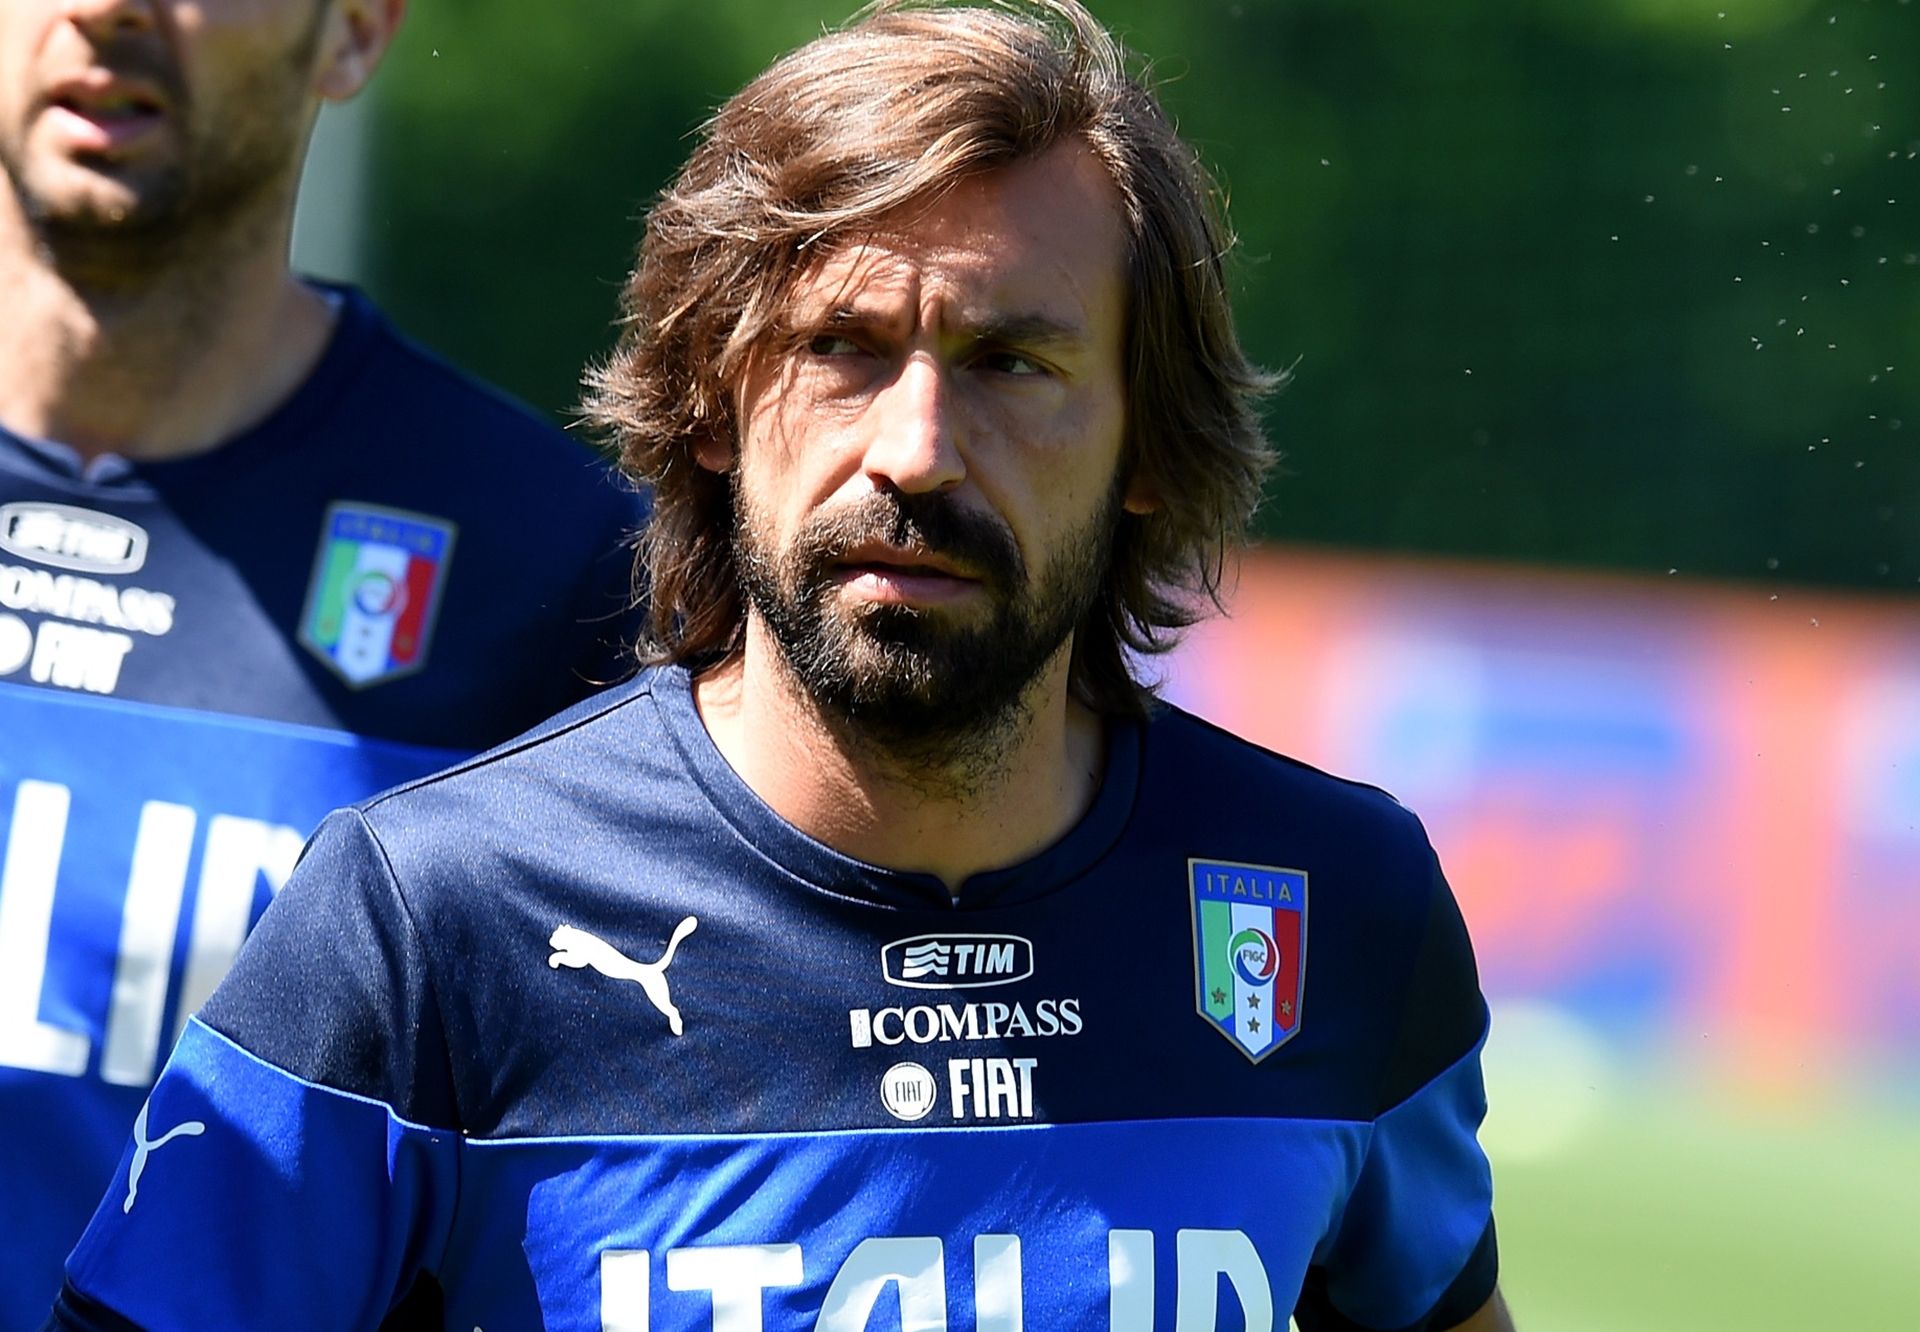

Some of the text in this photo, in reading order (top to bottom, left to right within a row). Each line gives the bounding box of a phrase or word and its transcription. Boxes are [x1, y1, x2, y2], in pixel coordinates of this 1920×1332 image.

[0, 563, 175, 636] OMPASS
[1206, 872, 1292, 902] ITALIA
[954, 943, 1015, 975] TIM
[1243, 949, 1265, 963] FIGC
[872, 998, 1083, 1046] COMPASS
[895, 1080, 922, 1102] FIAT
[949, 1057, 1038, 1119] FIAT
